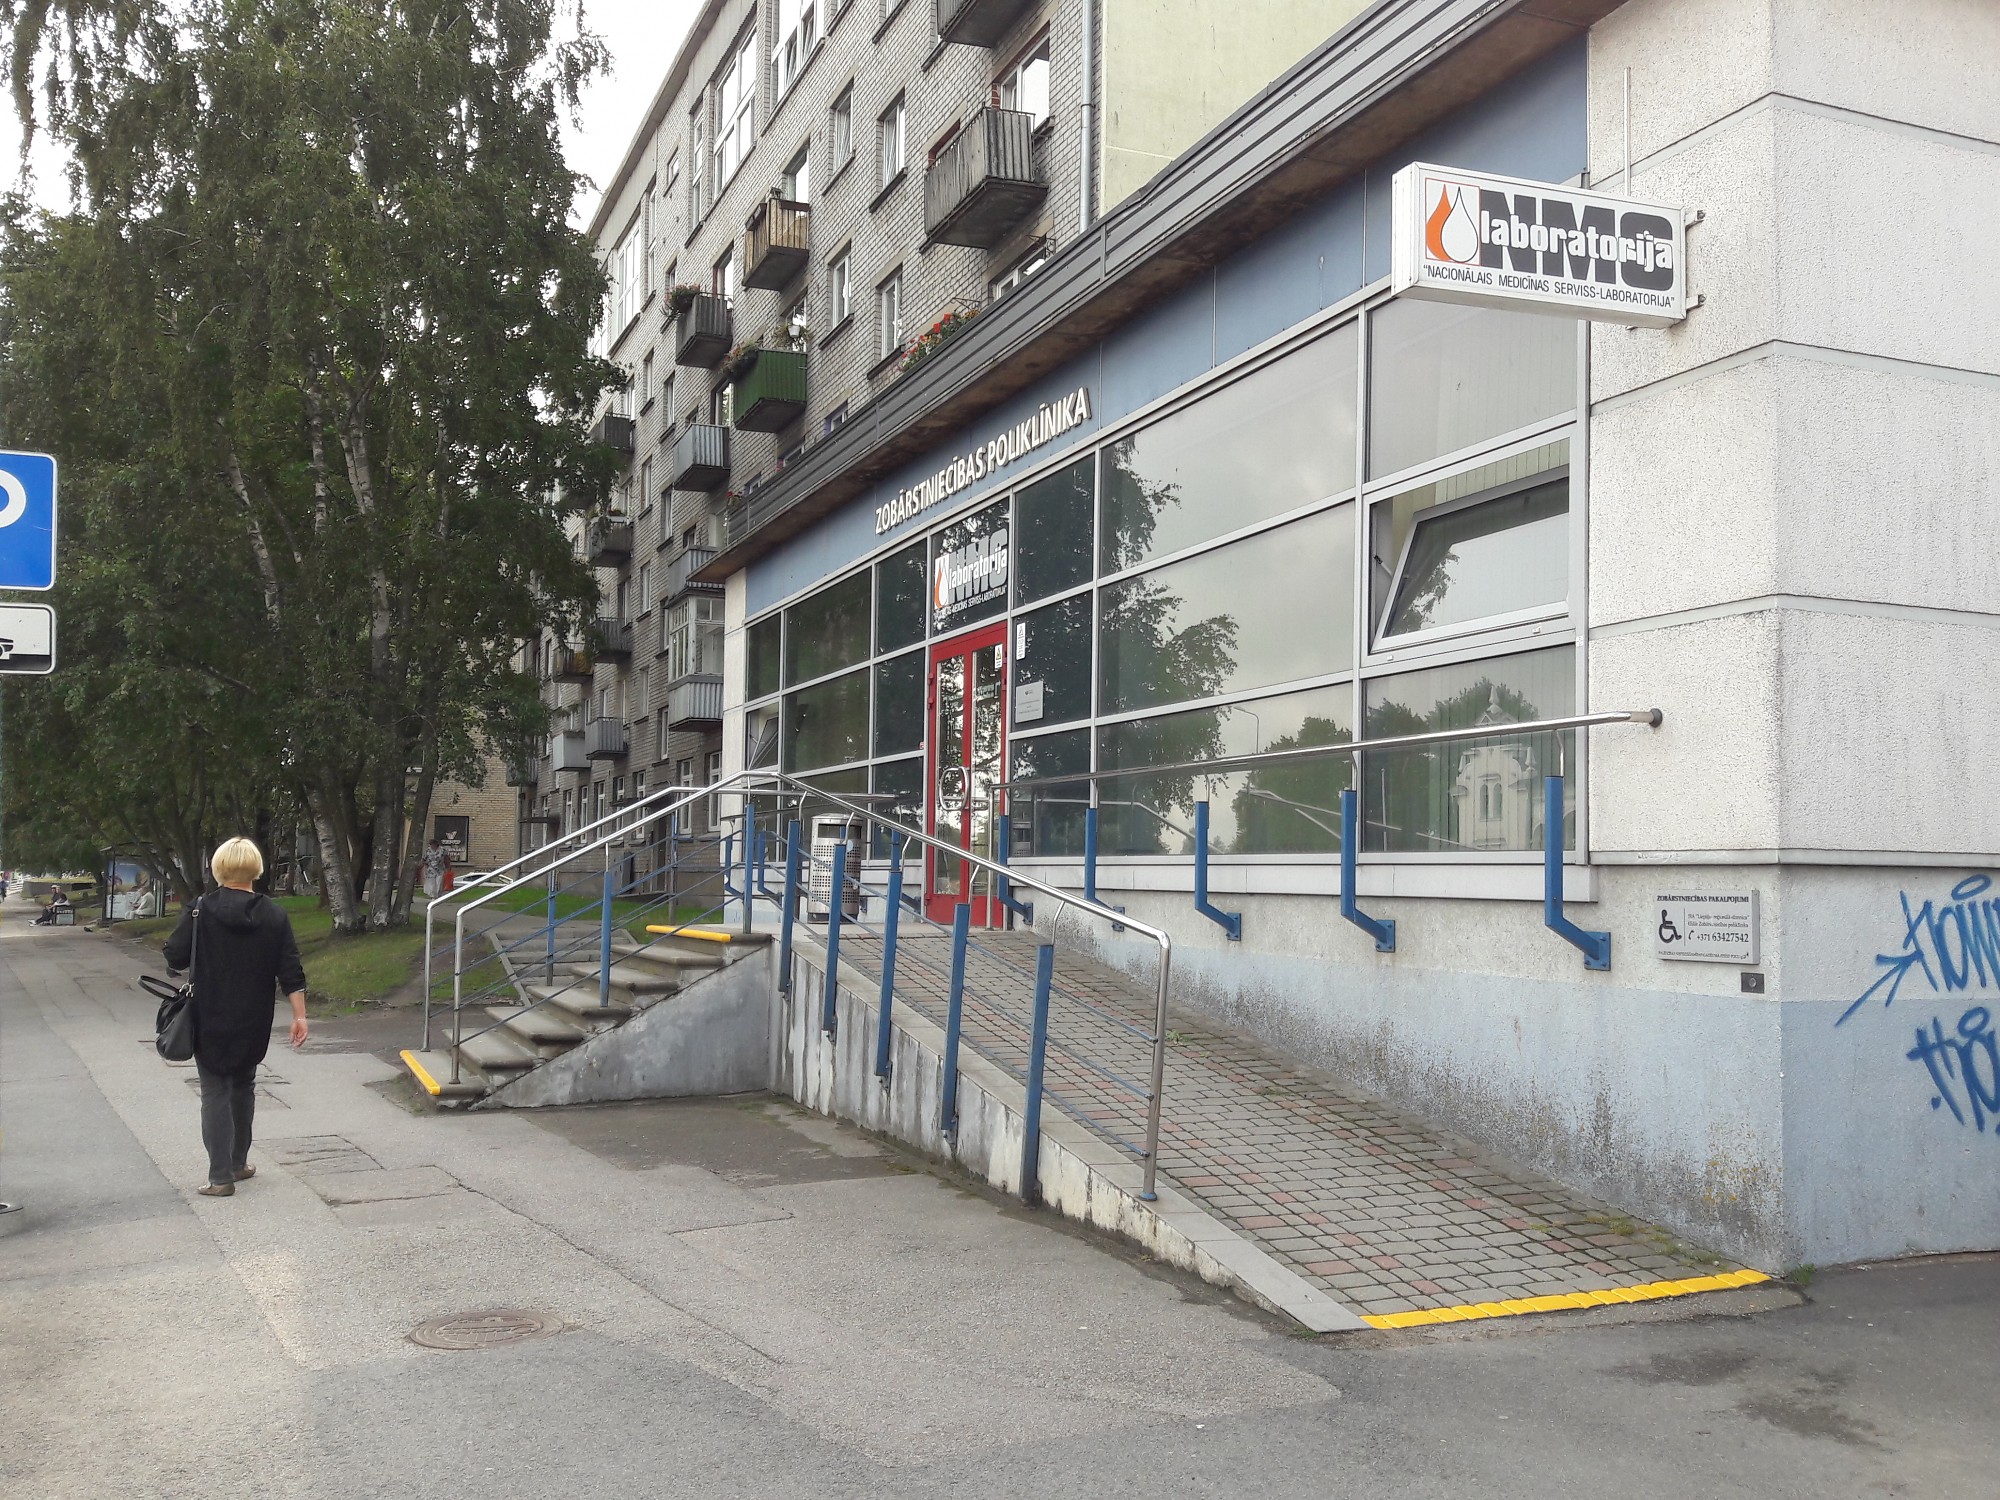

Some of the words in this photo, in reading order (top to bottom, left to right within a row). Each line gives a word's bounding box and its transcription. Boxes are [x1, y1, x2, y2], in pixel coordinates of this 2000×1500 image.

[1481, 210, 1673, 273] laboratorija
[1498, 274, 1549, 293] MEDICĪNAS
[876, 446, 986, 535] ZOBĀRSTNIECĪBAS
[987, 387, 1091, 472] POLIKLĪNIKA
[949, 546, 1008, 590] laboratorija
[1657, 894, 1708, 903] ZOBĀRSTNIECĪBAS
[1708, 895, 1749, 904] PAKALPOJUMI
[1697, 933, 1710, 941] +371
[1712, 932, 1749, 943] 63427542
